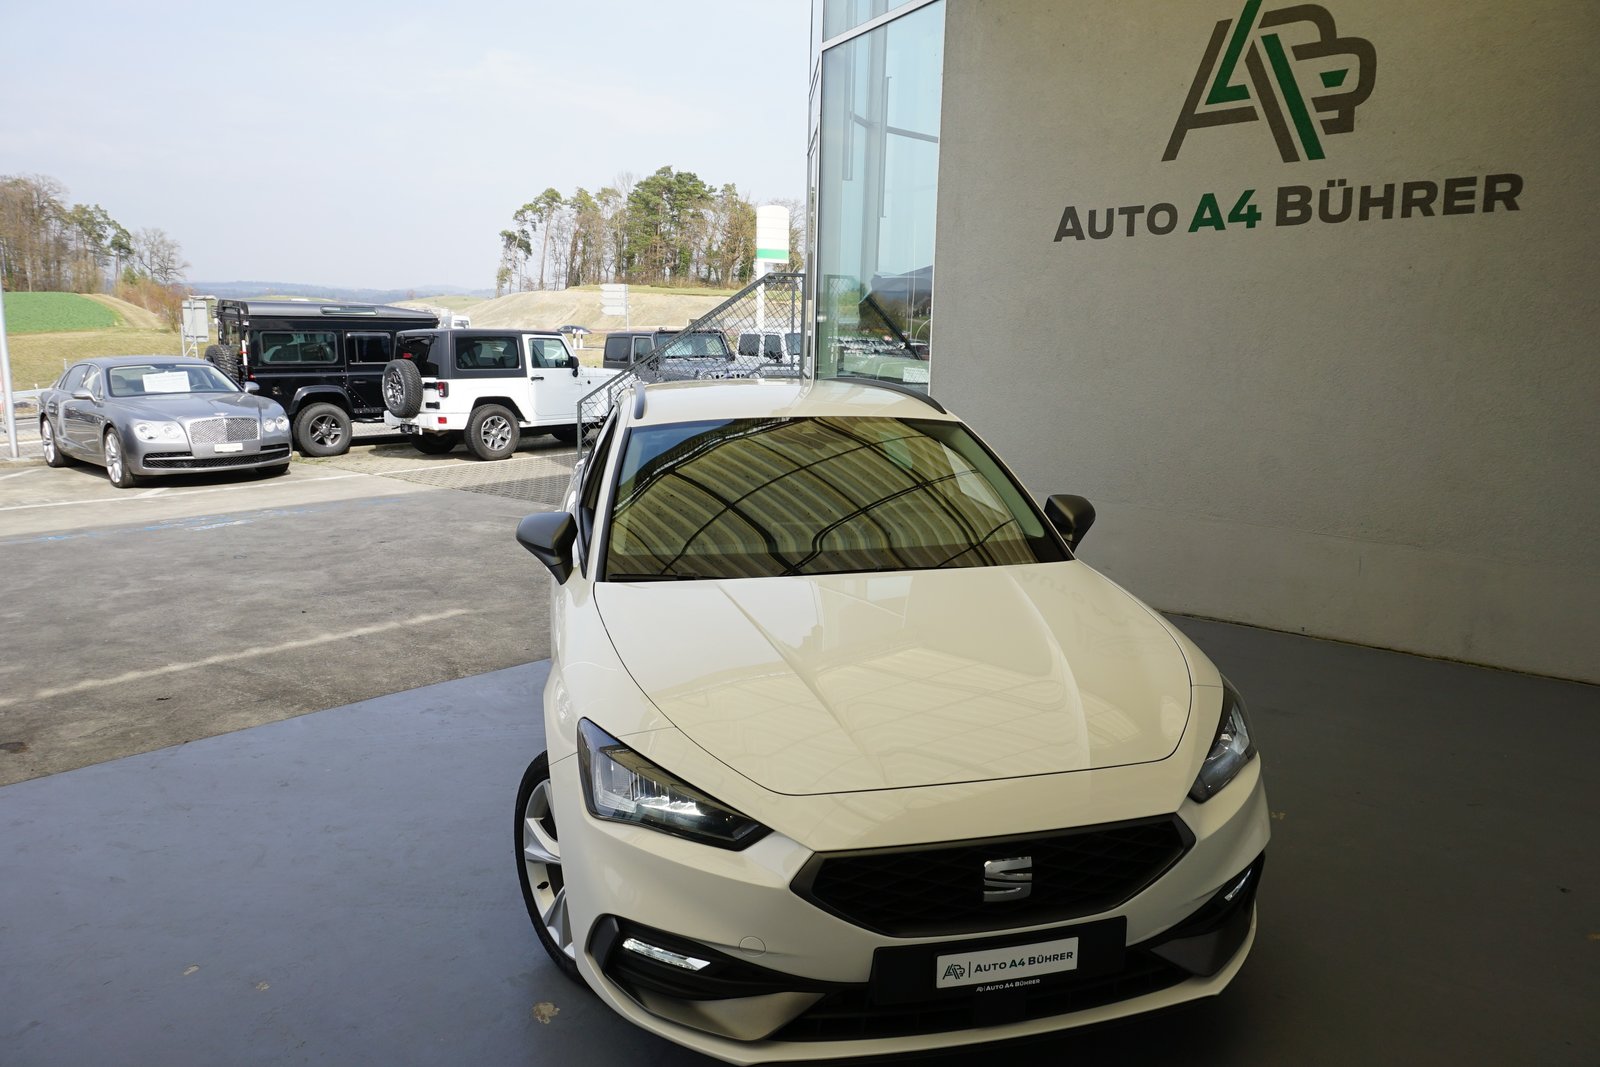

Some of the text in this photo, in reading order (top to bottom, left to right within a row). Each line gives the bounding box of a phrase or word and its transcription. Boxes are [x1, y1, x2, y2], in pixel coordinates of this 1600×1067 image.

[1053, 172, 1525, 243] AUTO A4 BÜHRER
[974, 962, 1007, 973] AUTO
[1008, 958, 1026, 968] A4
[1028, 951, 1074, 966] BÜHRER
[985, 984, 1004, 992] AUTO
